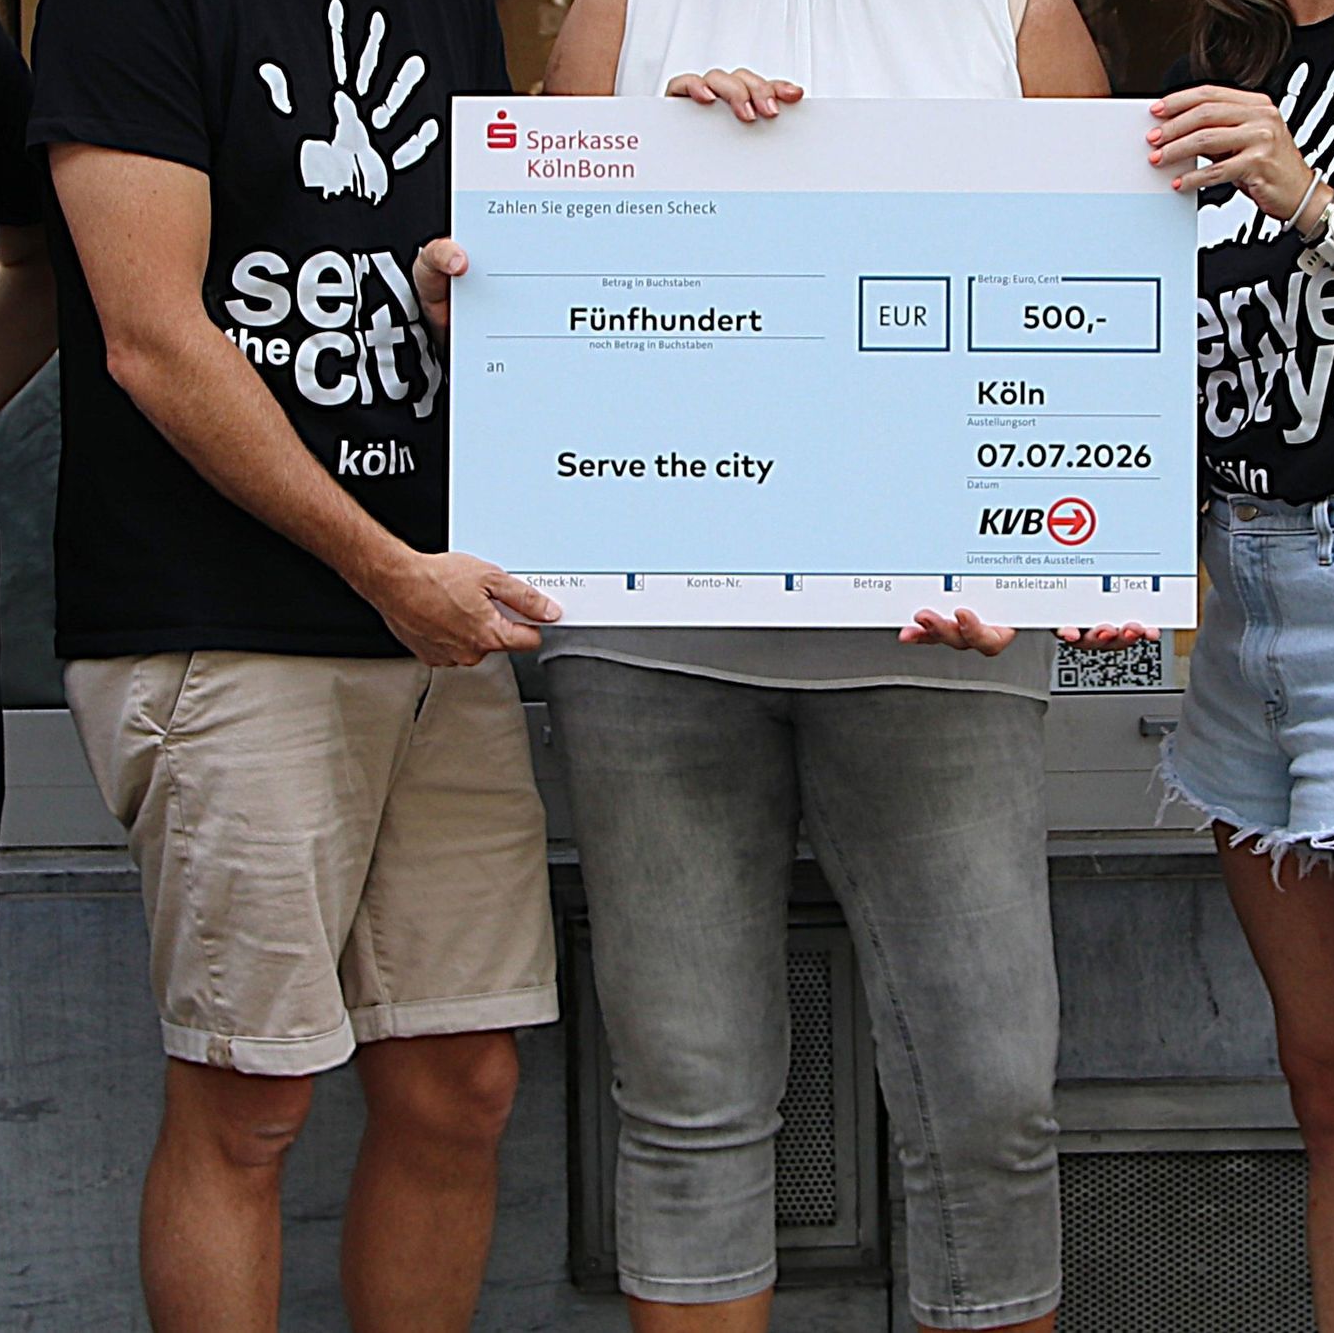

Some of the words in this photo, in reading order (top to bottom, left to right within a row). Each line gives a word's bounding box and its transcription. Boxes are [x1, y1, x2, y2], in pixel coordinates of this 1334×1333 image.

[527, 130, 639, 154] Sparkasse
[527, 159, 635, 179] KölnBonn
[487, 201, 537, 215] Zahlen
[541, 201, 563, 215] Sie
[567, 204, 612, 218] gegen
[616, 201, 663, 215] diesen
[667, 201, 717, 215] Scheck
[602, 278, 633, 290] Betrag
[635, 278, 644, 288] in
[646, 278, 702, 288] Buchstaben
[977, 274, 1011, 286] Betrag:
[1013, 274, 1036, 285] Euro,
[1038, 274, 1060, 285] Cent
[569, 306, 763, 332] Fünfhundert
[879, 305, 928, 327] EUR
[1023, 305, 1107, 334] 500,-
[589, 340, 612, 350] noch
[614, 340, 645, 352] Betrag
[647, 340, 656, 350] in
[658, 340, 714, 351] Buchstaben
[486, 361, 505, 373] an
[977, 380, 1046, 406] Köln
[337, 440, 415, 477] köln
[977, 443, 1152, 469] 07.07.2026
[556, 451, 646, 479] Serve
[654, 451, 707, 480] the
[715, 451, 775, 486] city
[967, 481, 1000, 490] Datum
[978, 508, 1045, 536] KVB
[967, 555, 1024, 565] Unterschrift
[1025, 555, 1042, 566] des
[1043, 556, 1095, 566] Ausstellers
[526, 576, 586, 587] Scheck-Nr.
[687, 577, 742, 588] Konto-Nr.
[853, 578, 892, 592] Betrag
[995, 578, 1068, 590] Bankleitzahl
[1124, 579, 1148, 590] Text
